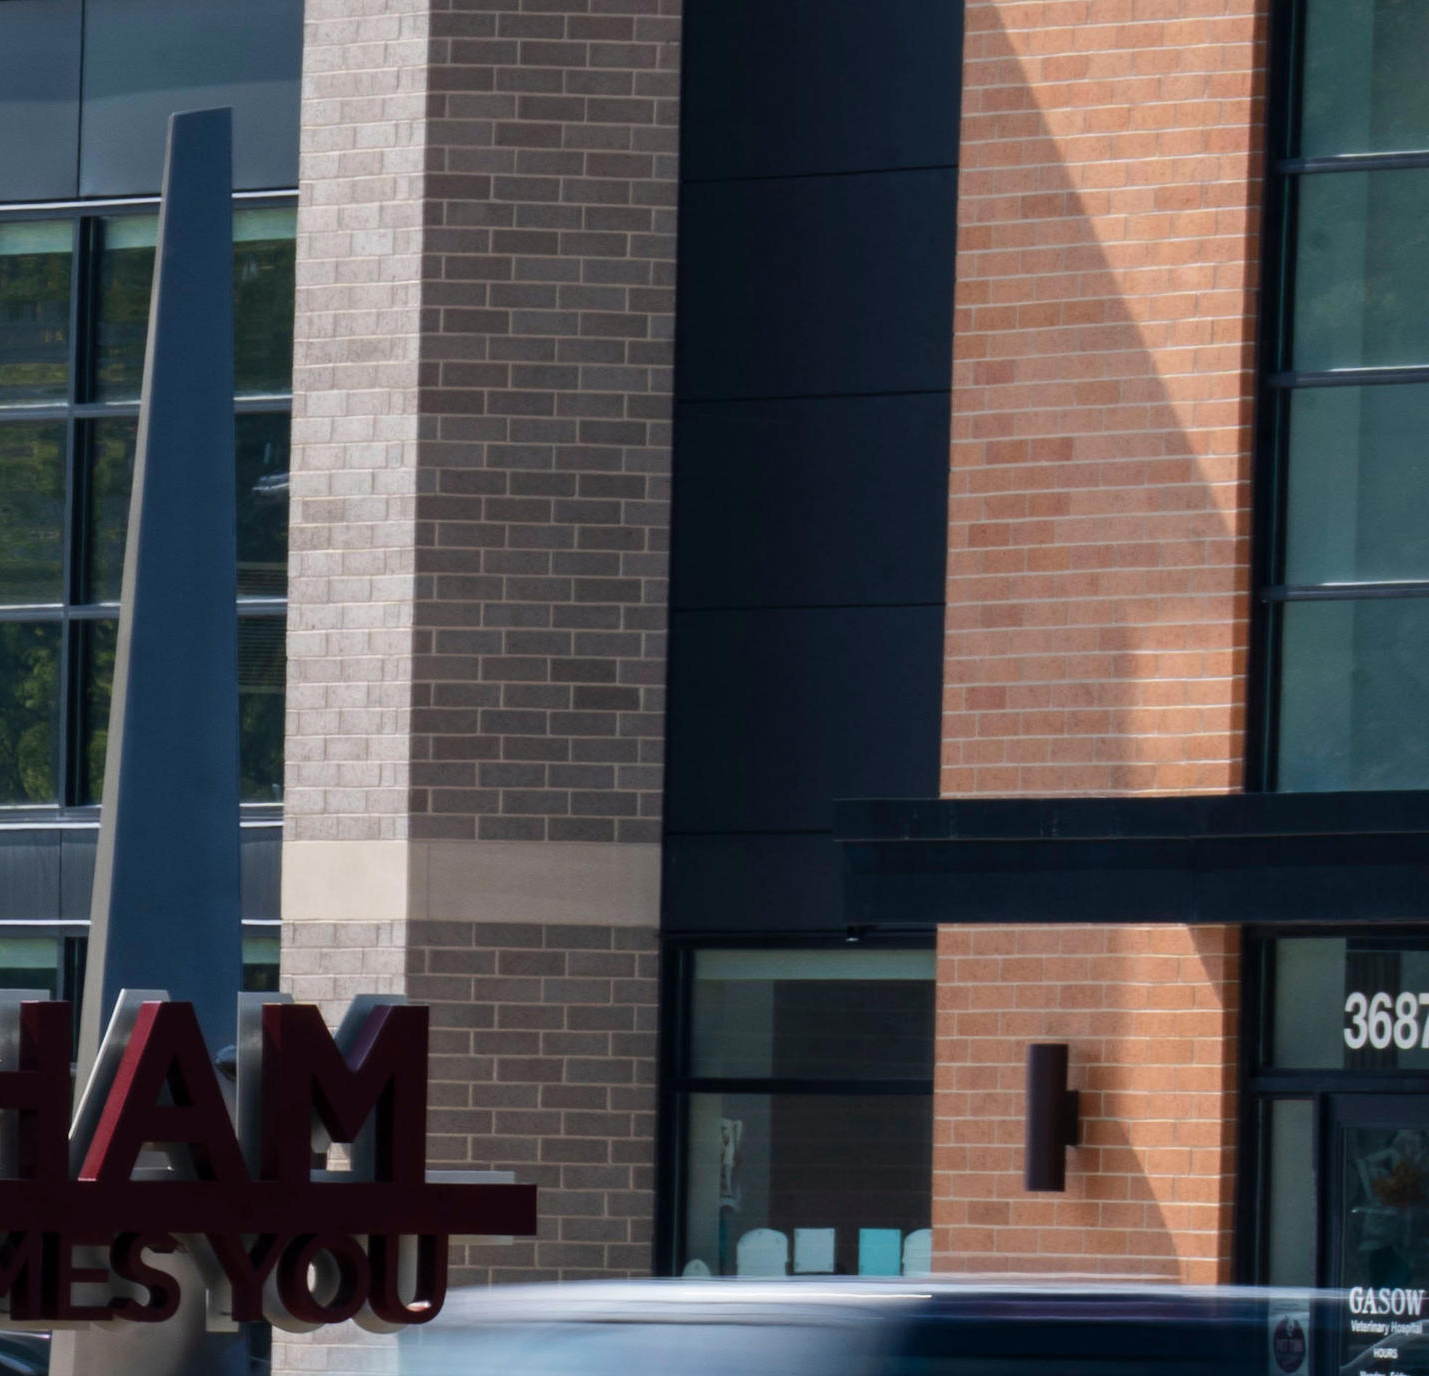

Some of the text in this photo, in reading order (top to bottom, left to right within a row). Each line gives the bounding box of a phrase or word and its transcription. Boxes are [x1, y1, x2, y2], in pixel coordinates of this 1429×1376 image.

[208, 1228, 449, 1326] YOU
[1349, 1286, 1425, 1316] GASOW
[1350, 1320, 1423, 1336] Veterinary Hospital
[1373, 1347, 1398, 1359] HOURS
